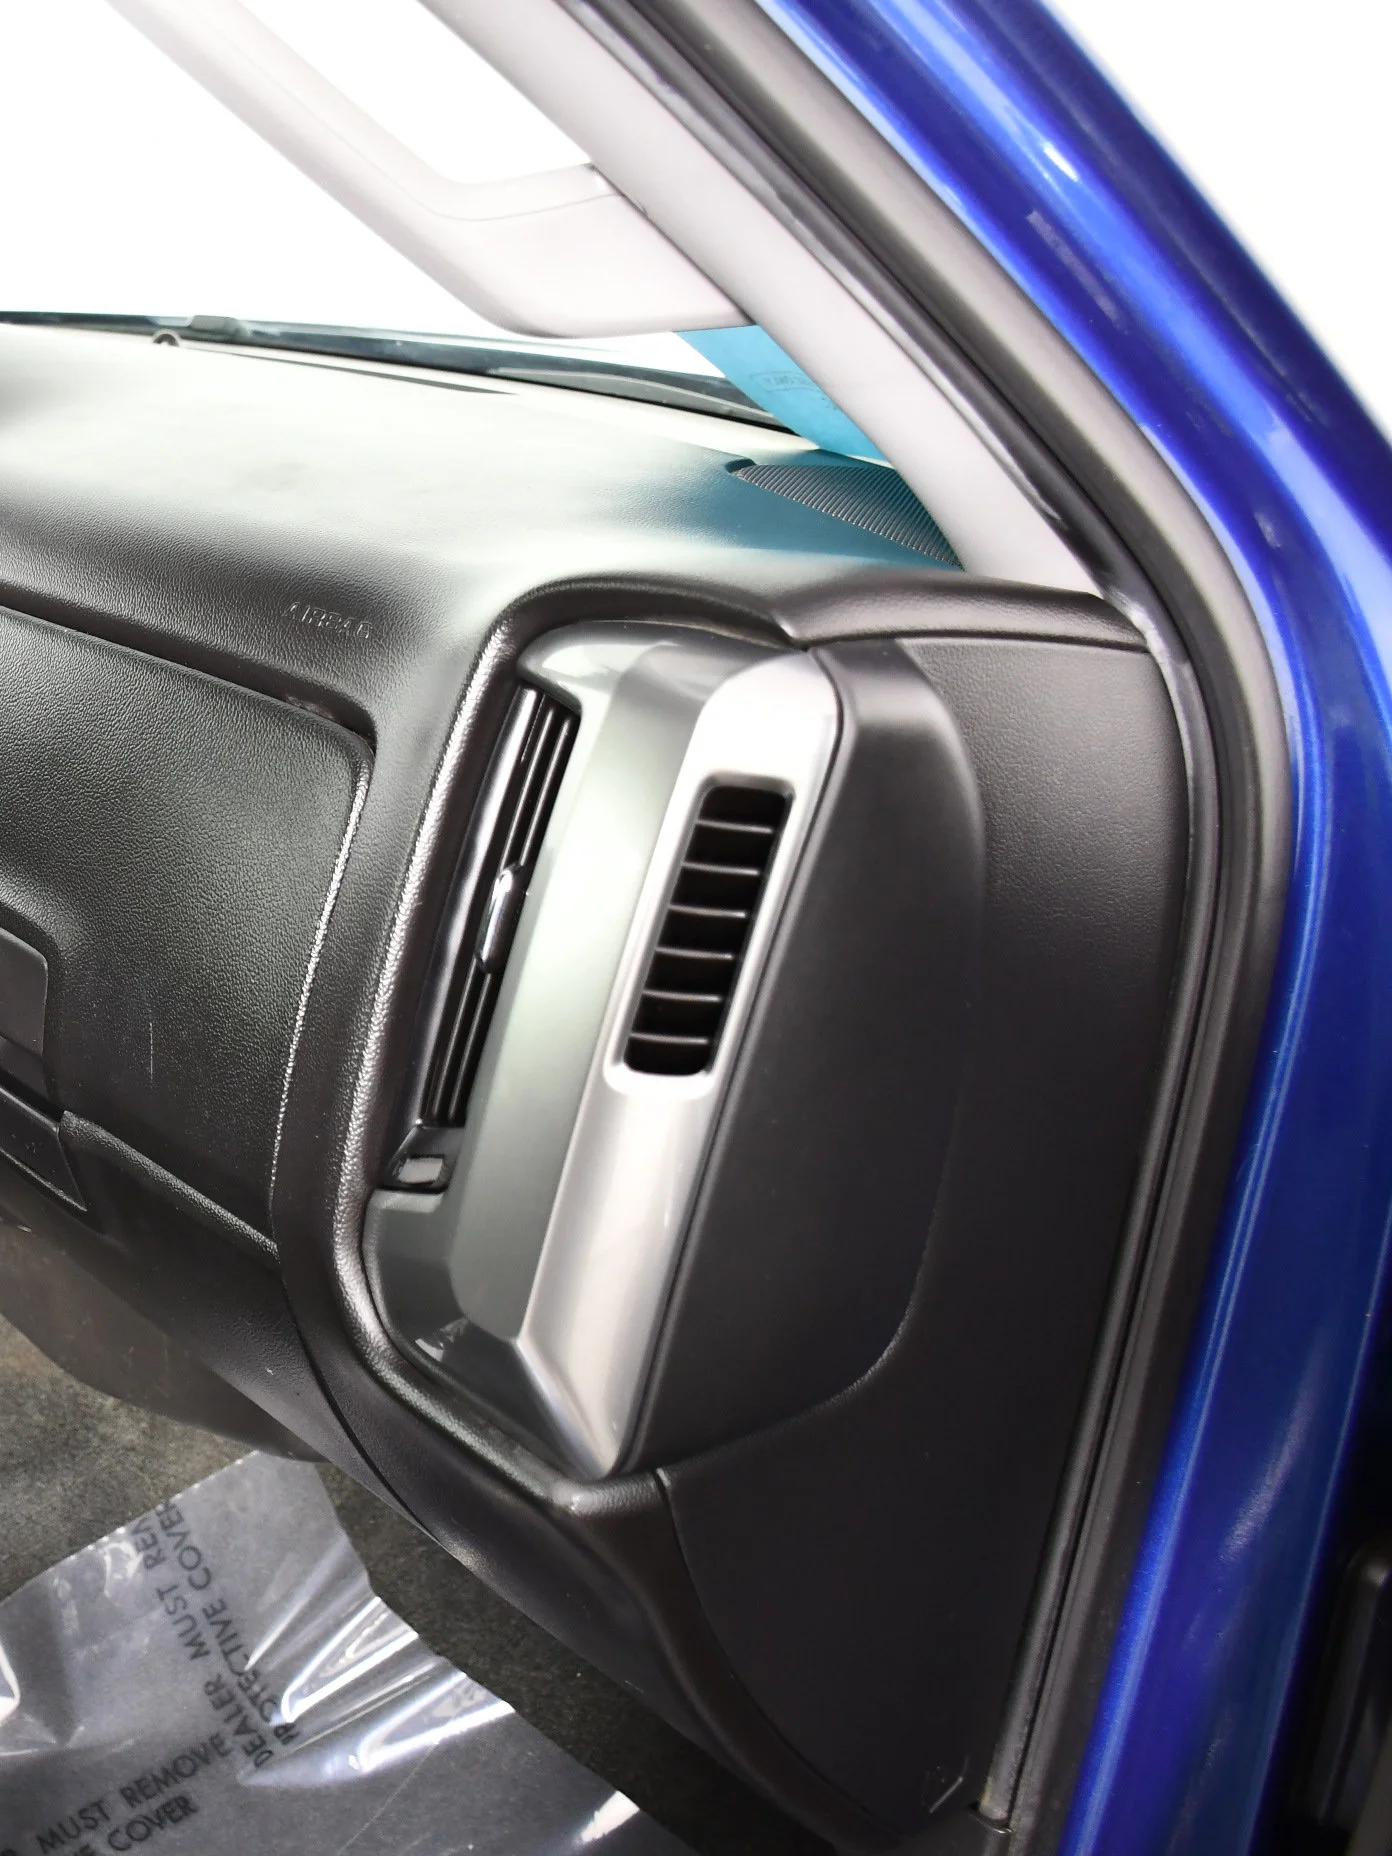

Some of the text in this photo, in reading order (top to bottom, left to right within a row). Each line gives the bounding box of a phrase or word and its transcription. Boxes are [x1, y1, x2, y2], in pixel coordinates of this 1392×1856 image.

[281, 601, 373, 639] AIRBAG
[156, 1584, 210, 1661] MUST
[204, 1673, 274, 1768] DEALER
[36, 1733, 231, 1854] MUST REMOVE
[108, 1796, 199, 1851] COVER
